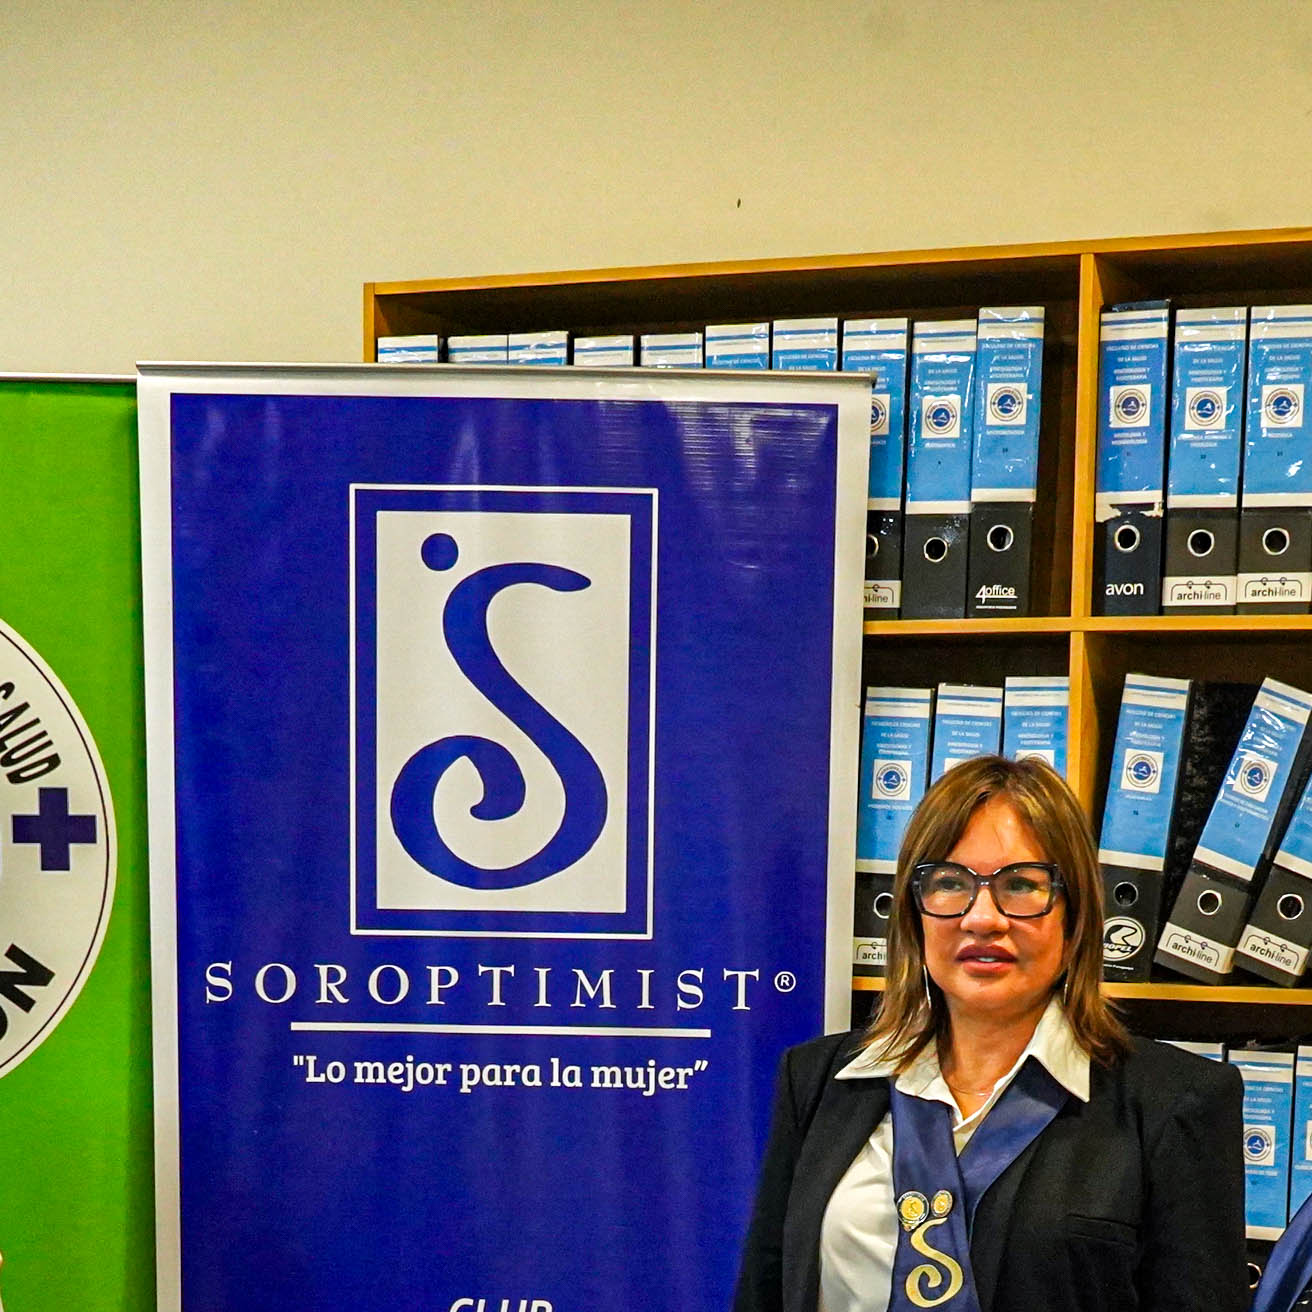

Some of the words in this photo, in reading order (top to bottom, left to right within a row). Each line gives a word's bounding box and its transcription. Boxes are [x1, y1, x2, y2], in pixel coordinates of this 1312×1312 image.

[1106, 581, 1144, 596] avon
[354, 1057, 451, 1092] mejor
[459, 1061, 541, 1093] para
[550, 1057, 583, 1087] la
